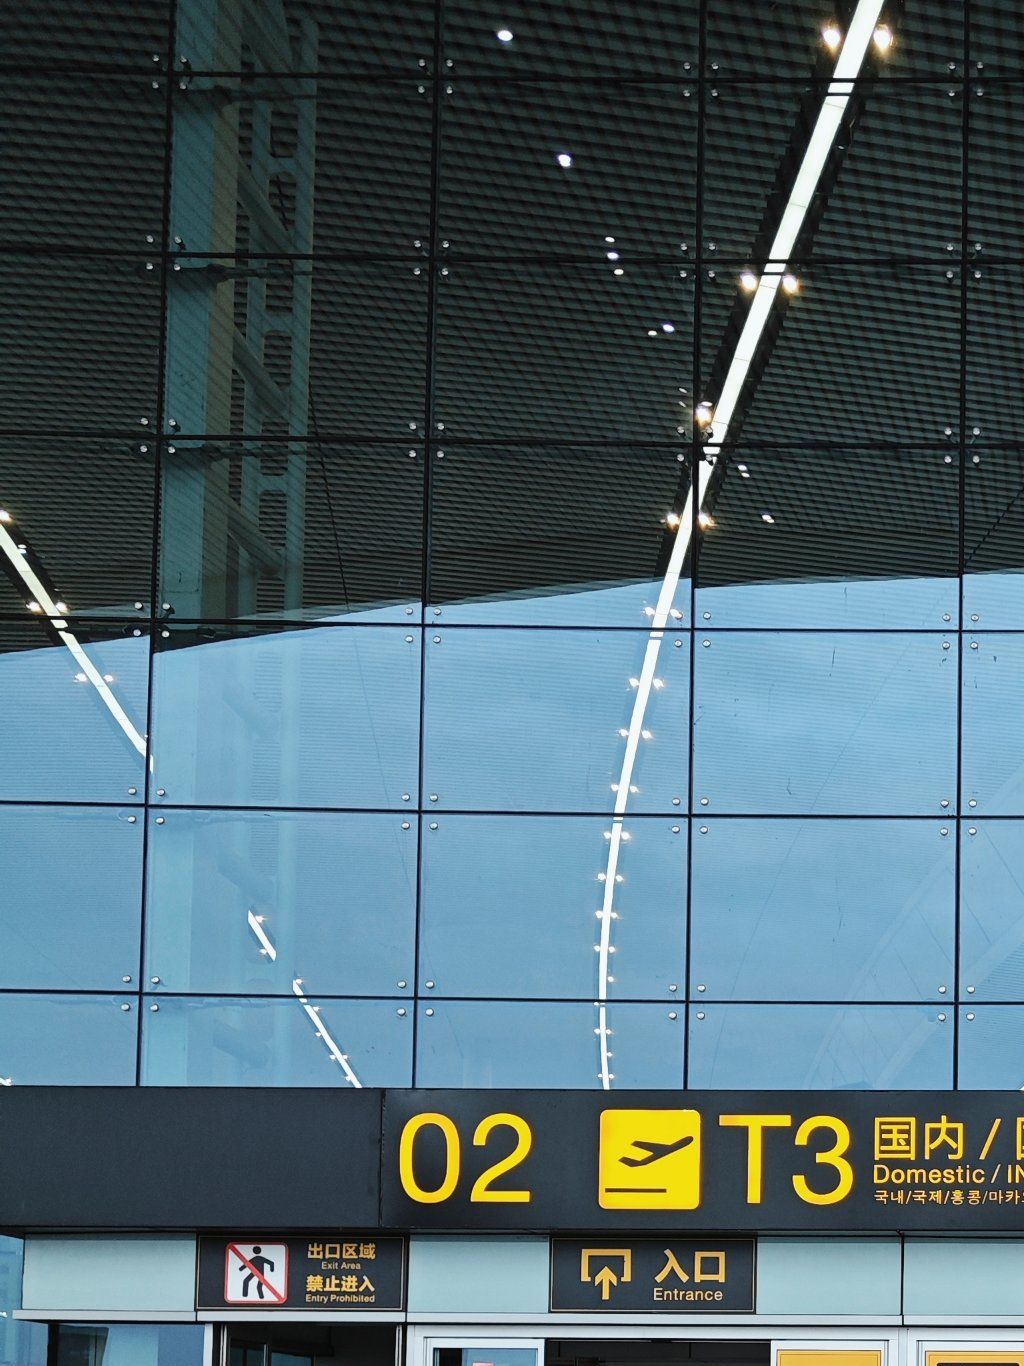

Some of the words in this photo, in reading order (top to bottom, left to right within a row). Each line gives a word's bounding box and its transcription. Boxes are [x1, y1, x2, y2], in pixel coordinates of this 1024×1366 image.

[873, 1114, 965, 1161] 国内
[399, 1112, 533, 1204] 02
[718, 1114, 854, 1206] T3
[873, 1164, 986, 1185] Domestic
[307, 1242, 376, 1260] 出口区域
[321, 1261, 339, 1271] Exit
[340, 1261, 361, 1270] Area
[654, 1248, 726, 1284] 入口
[306, 1275, 375, 1292] 禁止进入
[305, 1294, 329, 1304] Entry
[330, 1294, 376, 1303] Prohibited
[653, 1287, 724, 1301] Entrance
